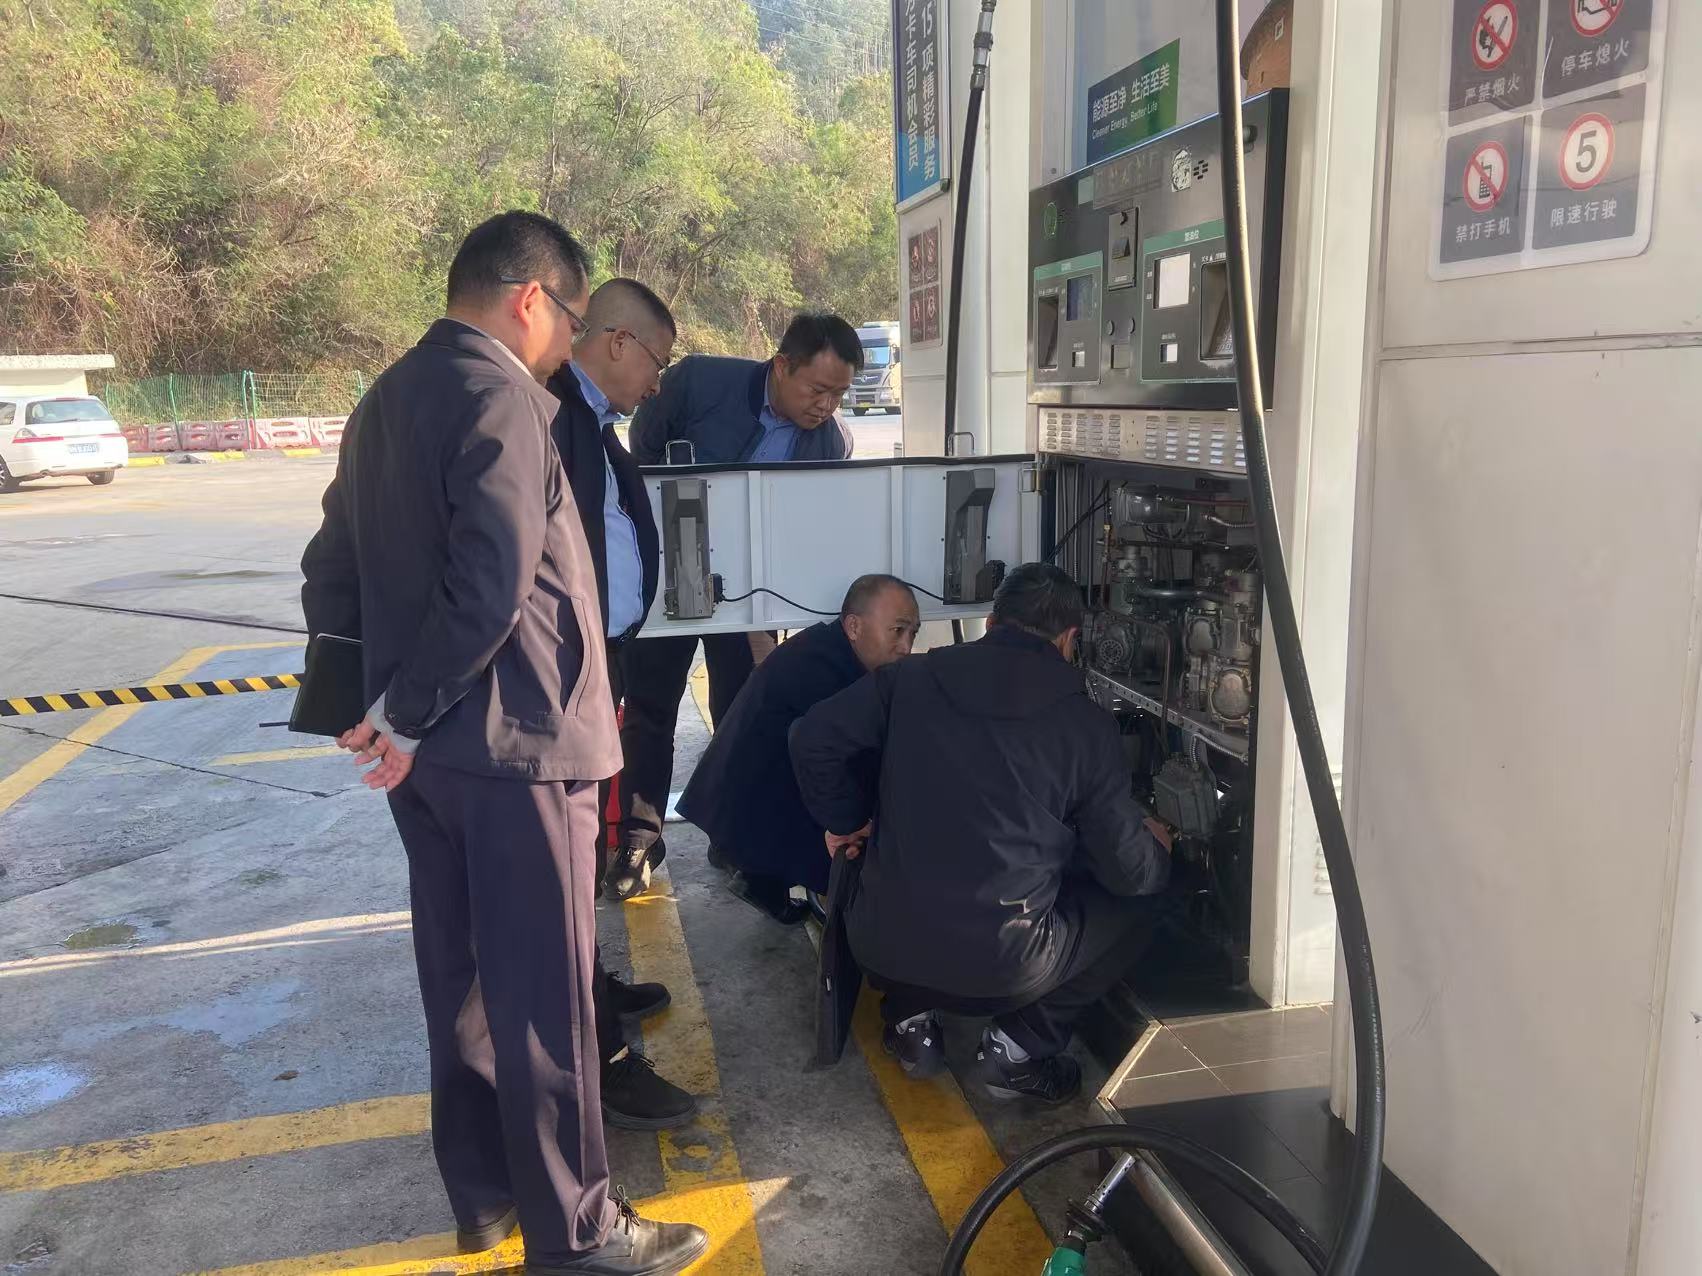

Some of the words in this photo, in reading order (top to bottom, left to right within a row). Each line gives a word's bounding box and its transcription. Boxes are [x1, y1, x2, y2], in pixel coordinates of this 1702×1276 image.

[1560, 38, 1630, 77] 停车熄火
[1092, 86, 1127, 123] 能源至净
[1131, 63, 1170, 103] 生活至美
[1464, 72, 1521, 106] 严禁烟火
[1131, 108, 1146, 121] Better
[1147, 101, 1158, 114] Life
[1575, 130, 1598, 173] 5
[1456, 217, 1511, 243] 禁打手机
[1551, 199, 1617, 228] 限速行驶
